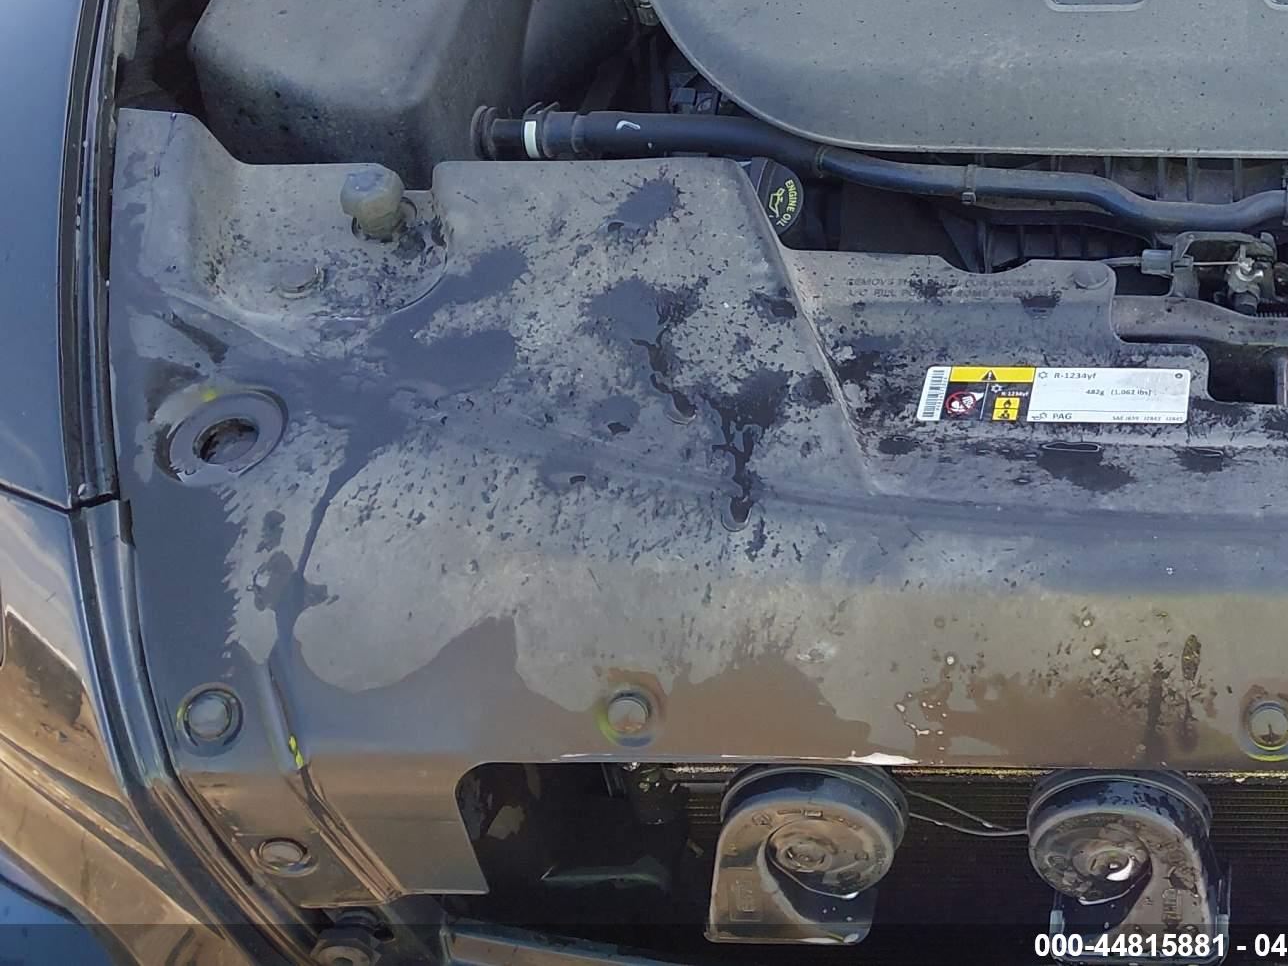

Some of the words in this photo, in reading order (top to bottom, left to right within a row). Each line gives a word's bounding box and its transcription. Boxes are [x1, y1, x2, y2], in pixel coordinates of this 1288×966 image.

[784, 179, 798, 212] ENGINE
[776, 213, 791, 227] OIL
[1053, 371, 1097, 381] R-1234yf
